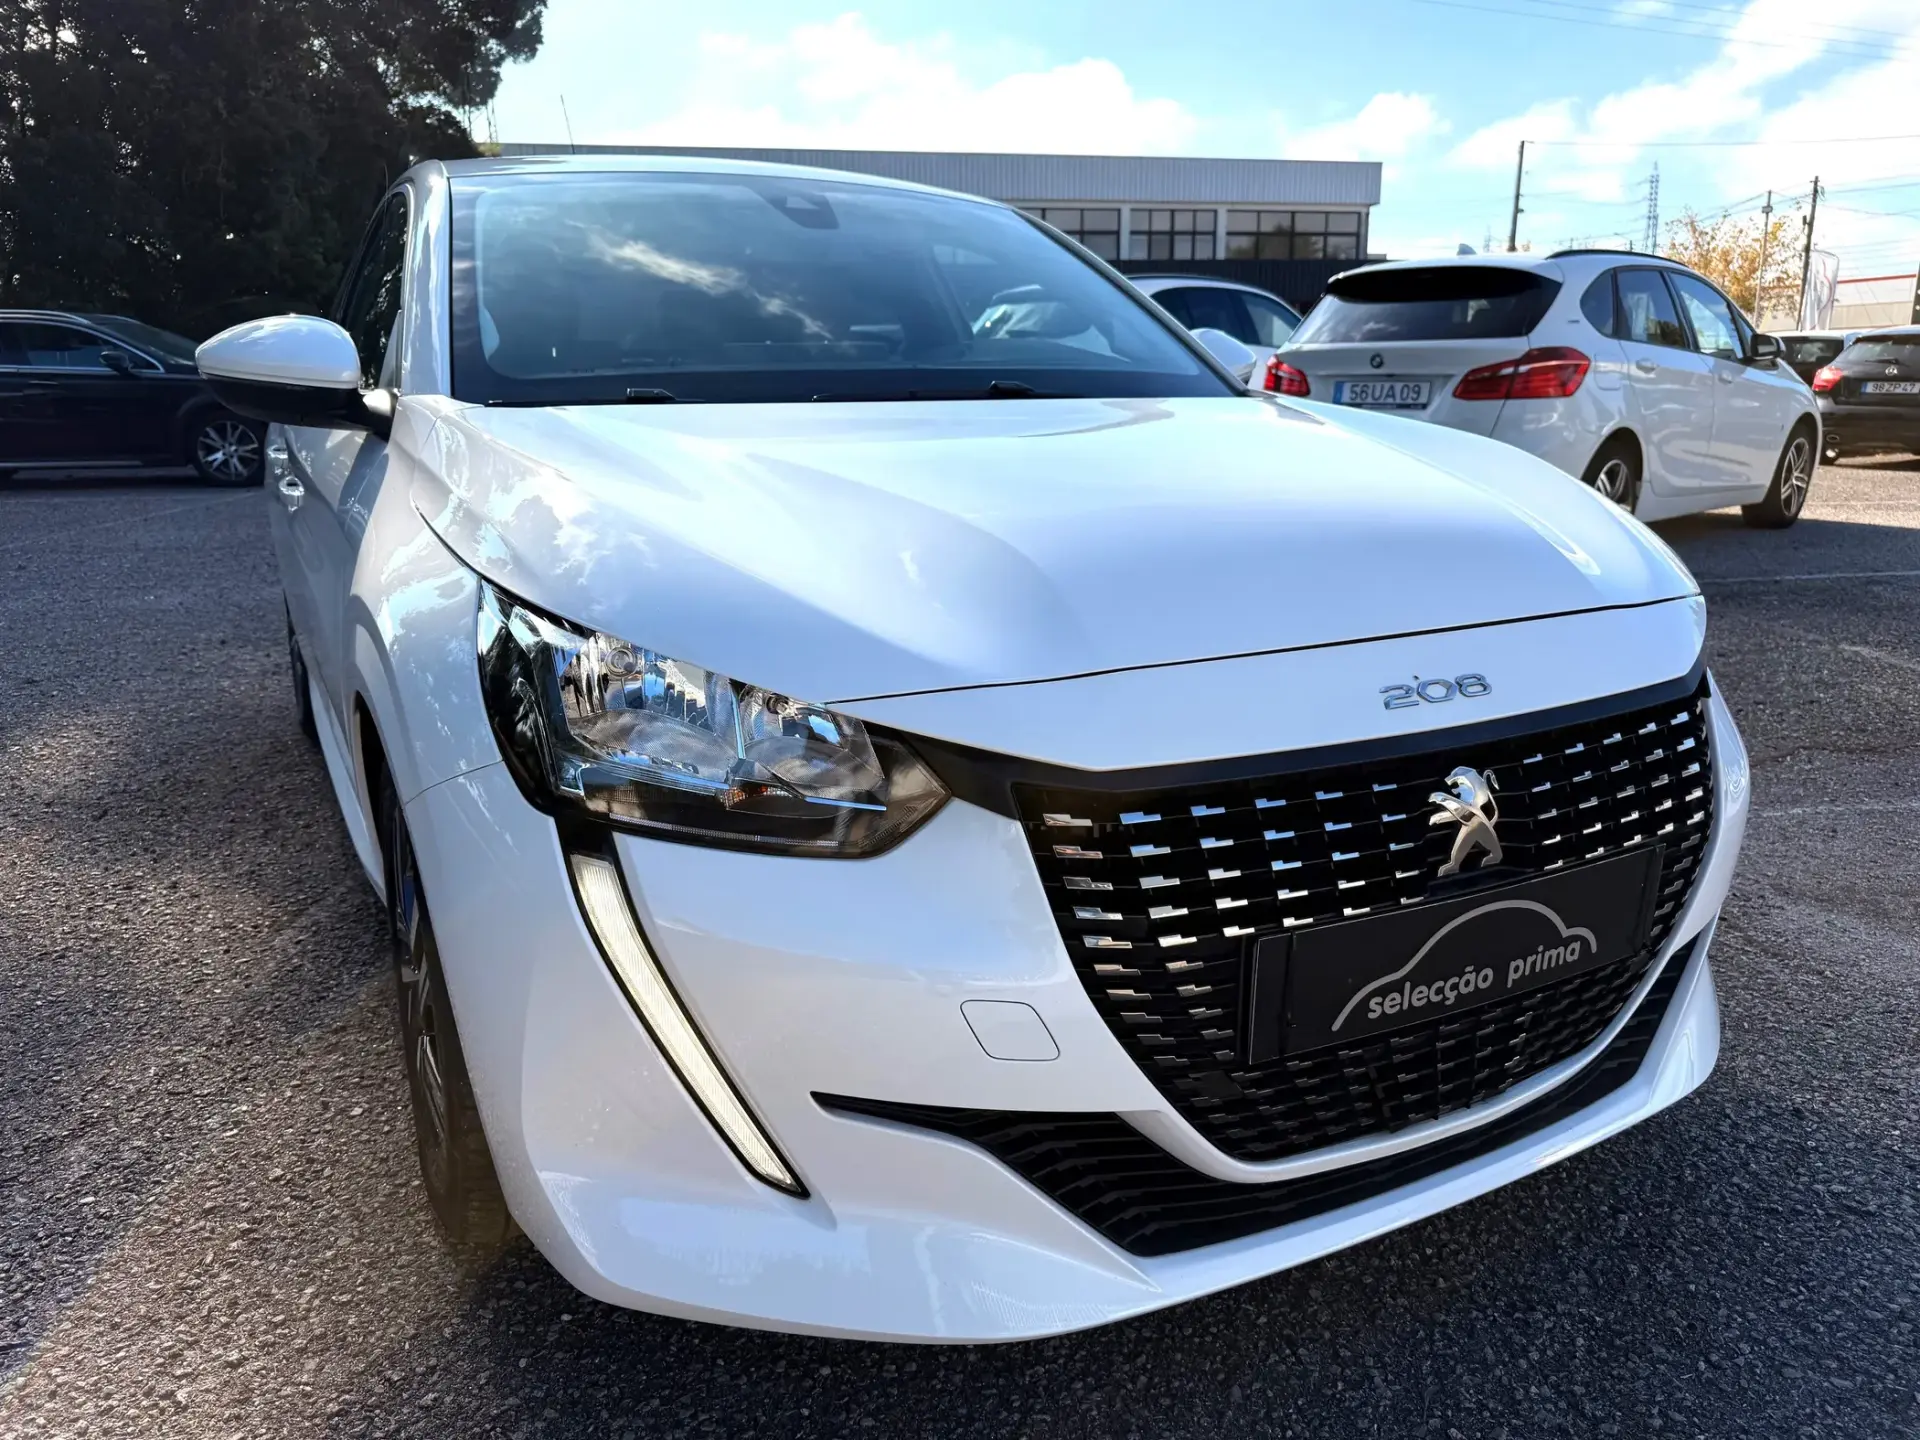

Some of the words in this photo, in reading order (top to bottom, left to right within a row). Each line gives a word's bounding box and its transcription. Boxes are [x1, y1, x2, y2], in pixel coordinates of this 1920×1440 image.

[1378, 673, 1493, 710] 208
[1367, 965, 1495, 1019] selecção
[1507, 941, 1581, 988] prima
